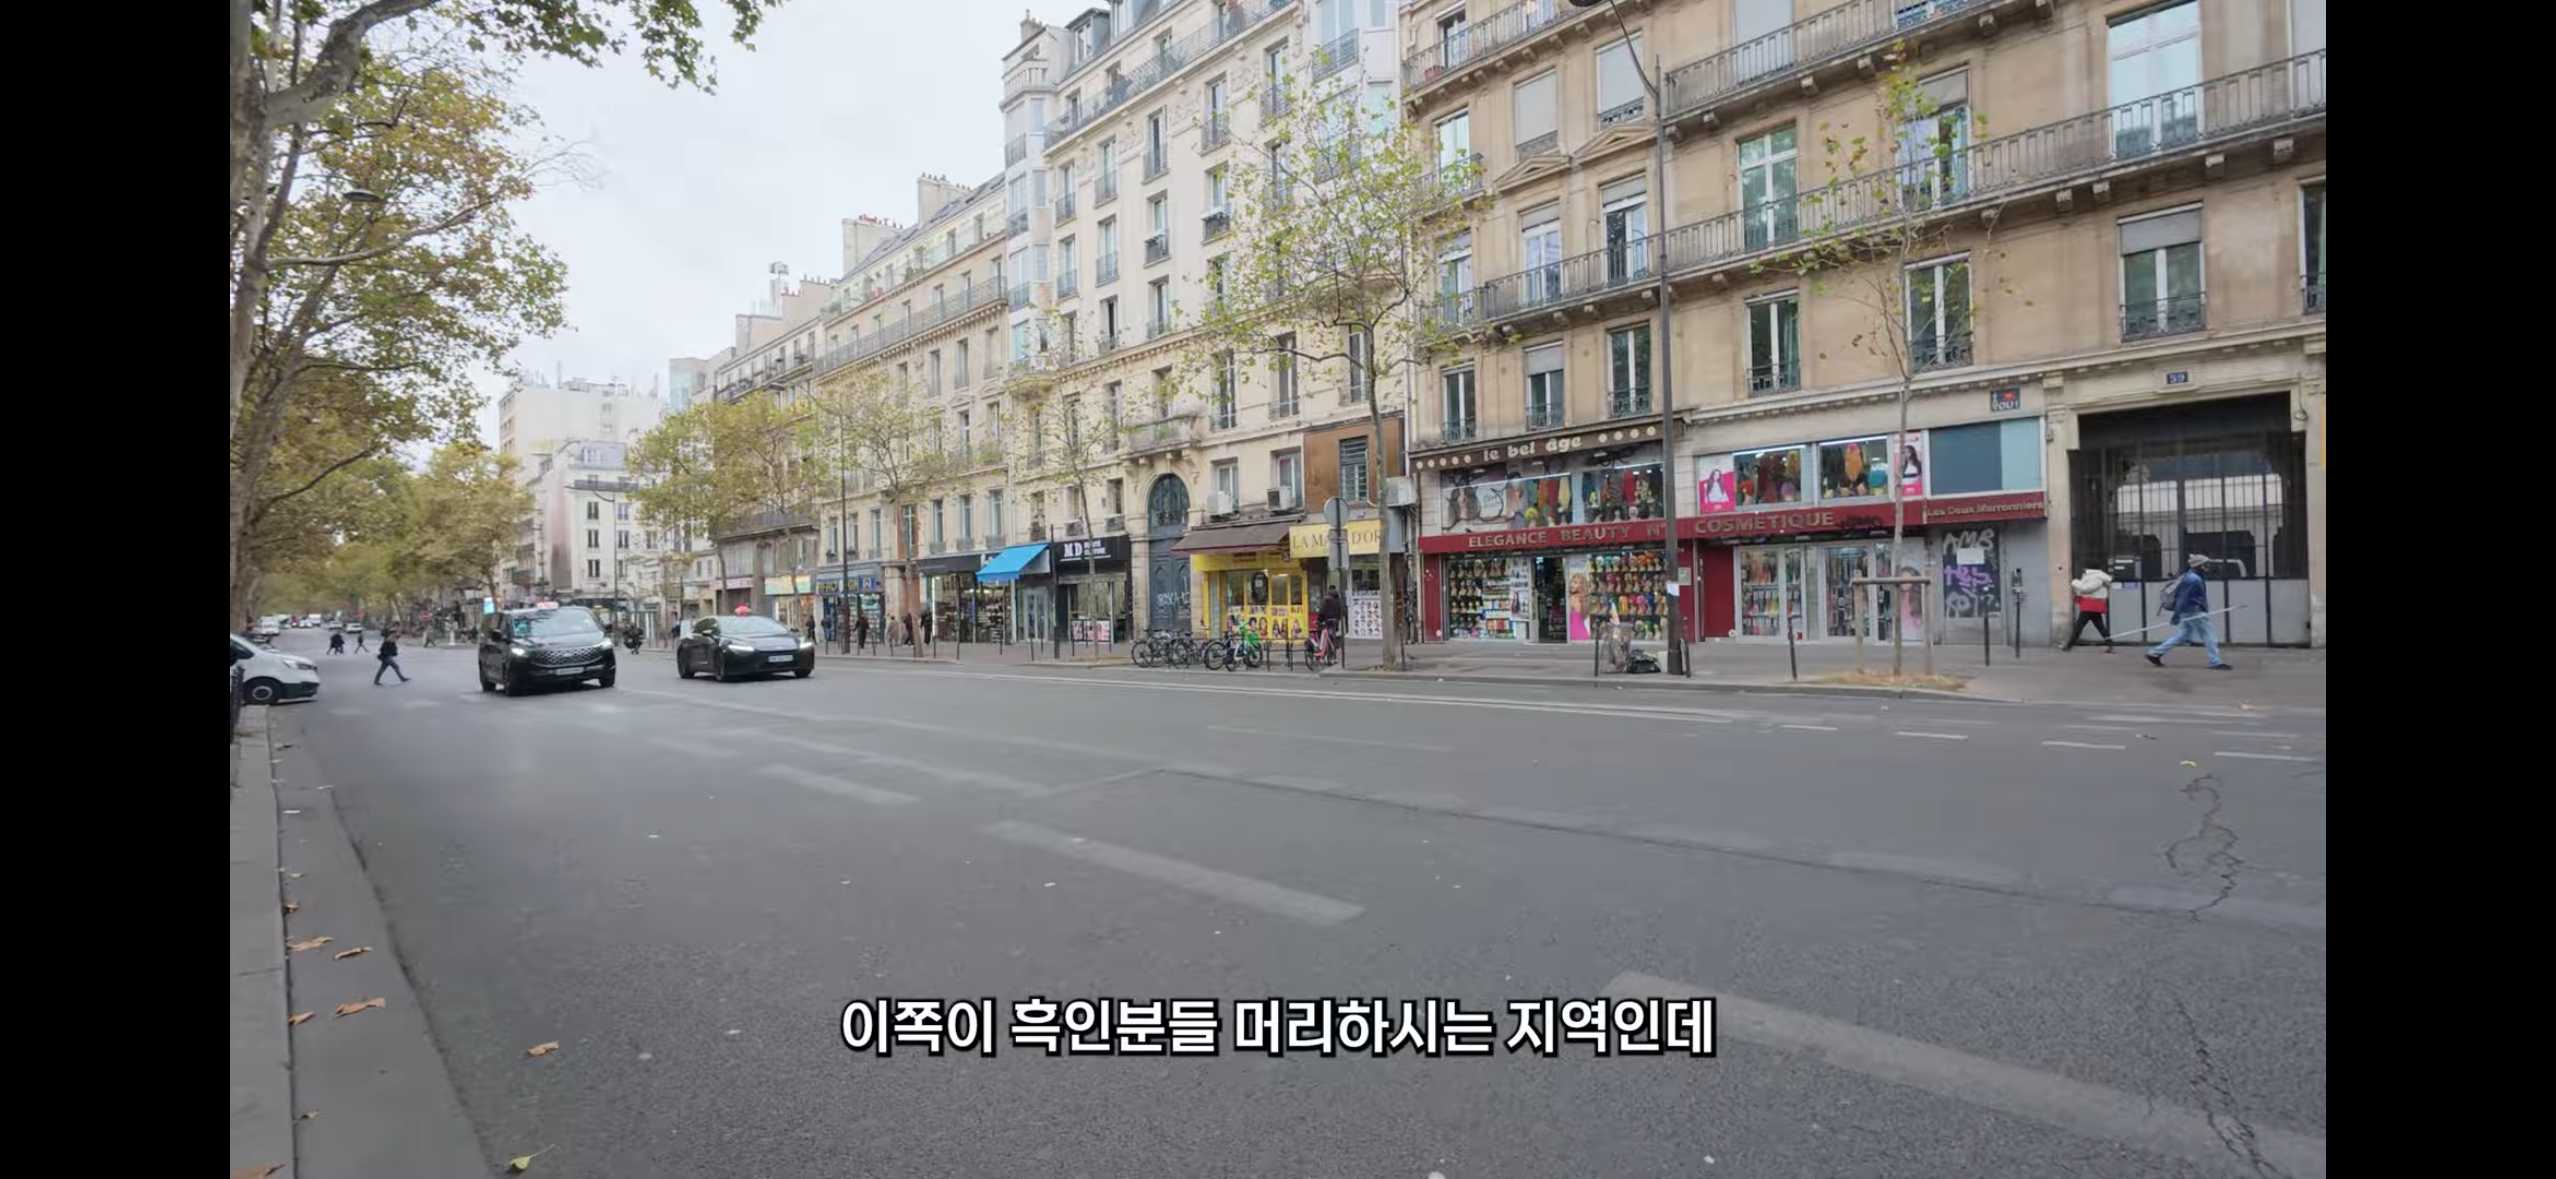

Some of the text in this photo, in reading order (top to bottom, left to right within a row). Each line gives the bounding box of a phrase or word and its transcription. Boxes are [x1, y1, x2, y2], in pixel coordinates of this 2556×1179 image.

[2169, 373, 2186, 383] 59
[1483, 436, 1582, 462] le bel âge
[1927, 508, 1946, 516] Les
[1948, 505, 1976, 515] Deux
[1469, 531, 1547, 548] ELEGANCE
[1561, 525, 1631, 542] BEAUTY
[1695, 512, 1836, 534] COSMETIQUE
[1292, 535, 1309, 549] LA
[1064, 542, 1082, 558] MD
